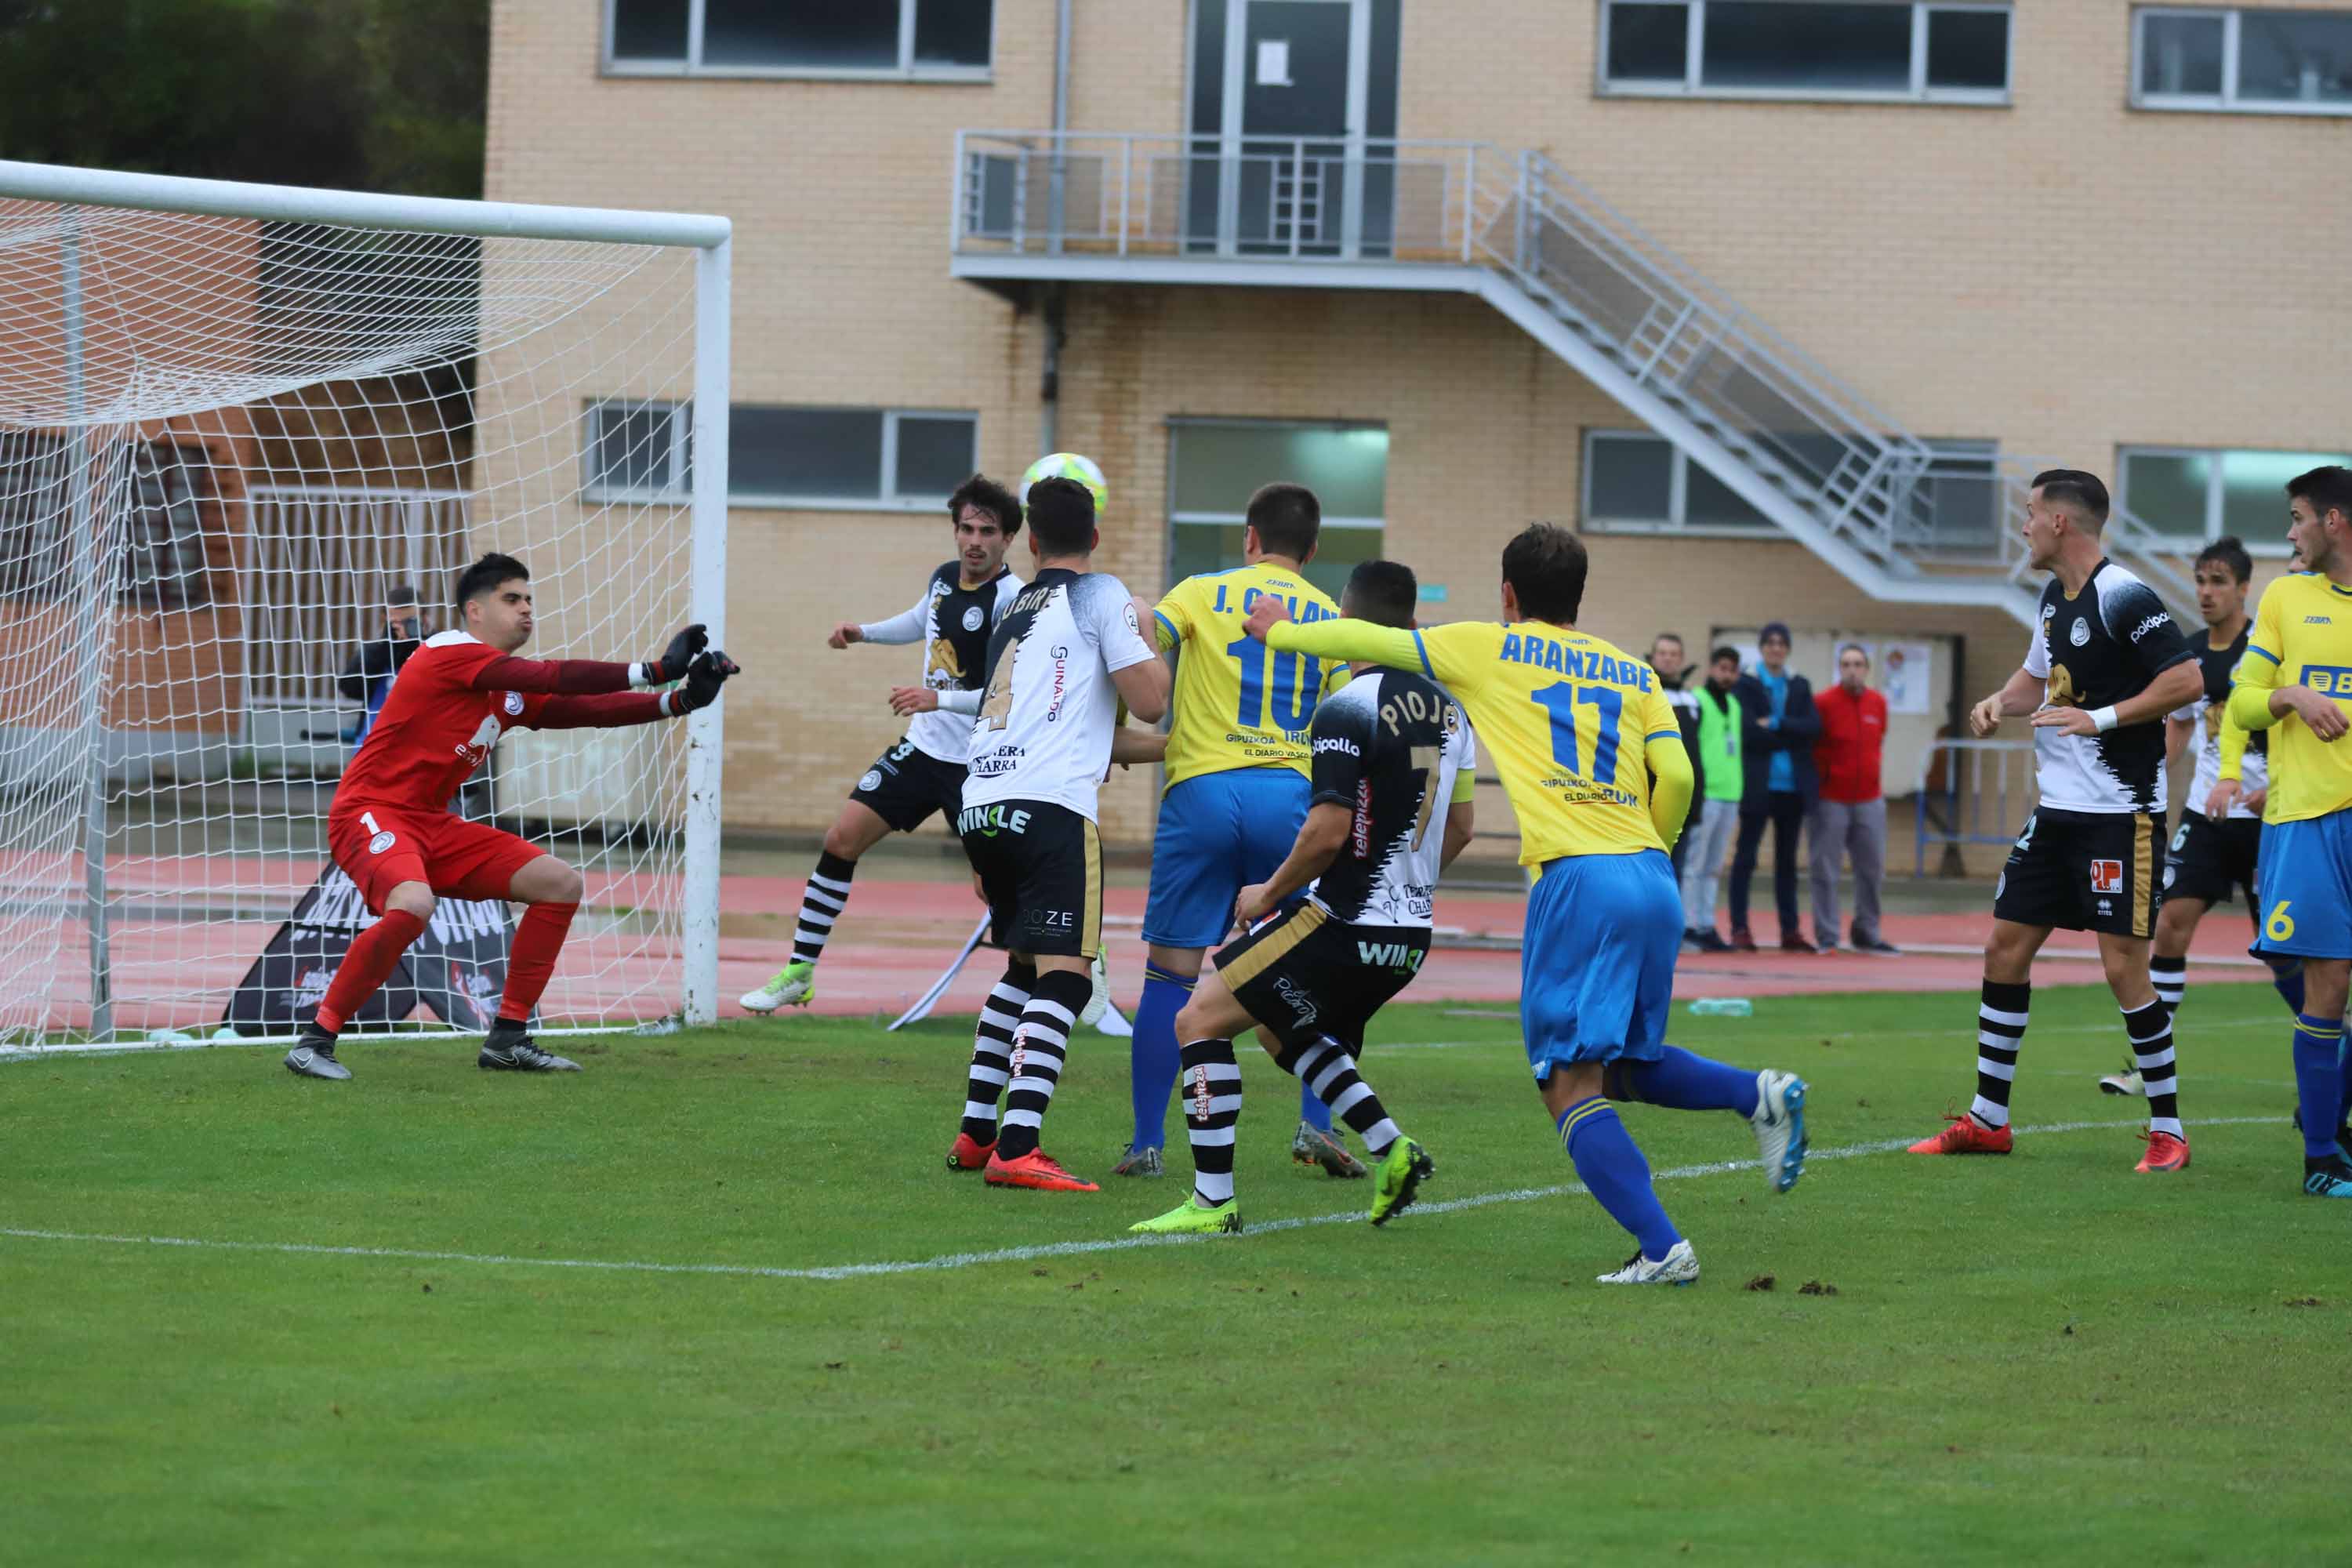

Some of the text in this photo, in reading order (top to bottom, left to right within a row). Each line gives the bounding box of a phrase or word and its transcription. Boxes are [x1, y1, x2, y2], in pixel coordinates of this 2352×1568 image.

[1213, 585, 1232, 614] J.
[2130, 612, 2171, 645] pakipa
[1499, 633, 1653, 694] ARANZABE
[1226, 632, 1323, 732] 10
[1380, 688, 1459, 737] PIOJO
[1225, 734, 1276, 744] GIPUZKOA
[1531, 680, 1622, 786] 17
[1410, 745, 1441, 853] 7
[1564, 793, 1576, 801] EL
[359, 811, 381, 836] 1
[2171, 822, 2191, 852] 6
[2267, 900, 2295, 942] 6
[1357, 940, 1425, 973] WINKL
